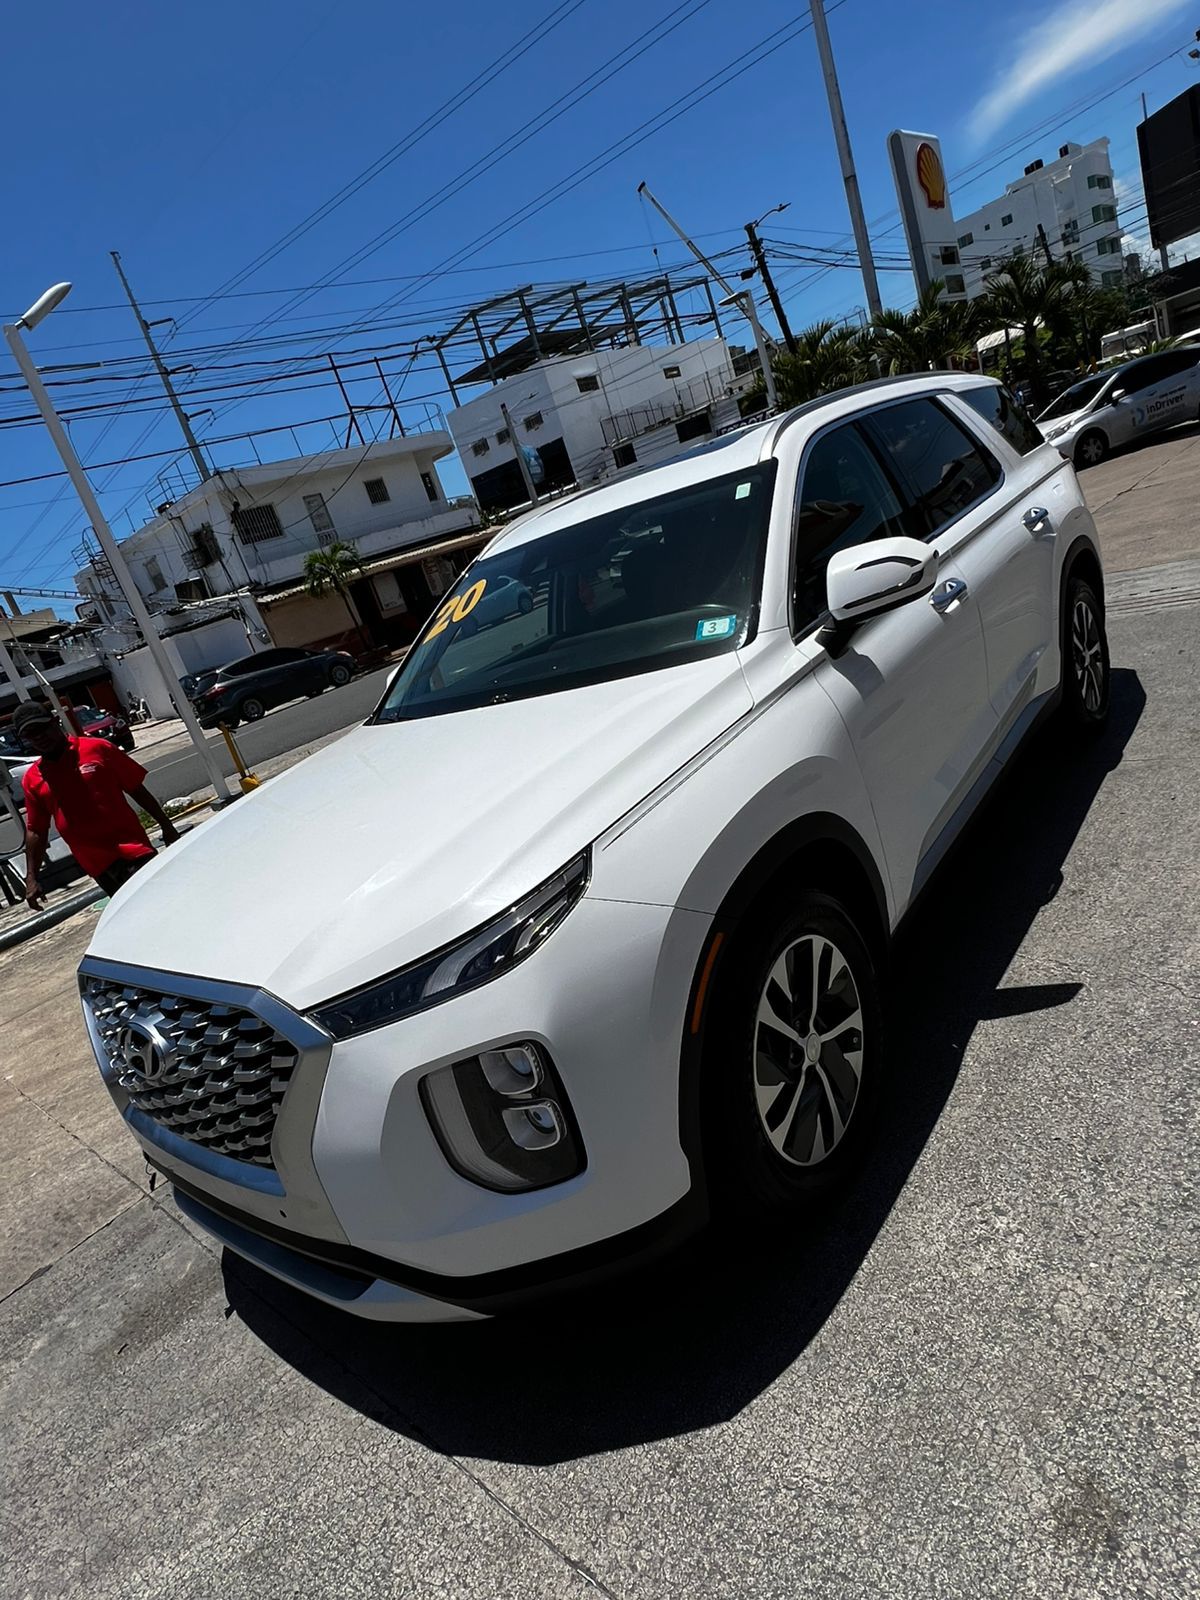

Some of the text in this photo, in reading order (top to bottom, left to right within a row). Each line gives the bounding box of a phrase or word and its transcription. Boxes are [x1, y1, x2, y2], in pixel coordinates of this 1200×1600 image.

[1146, 394, 1185, 414] inDriver
[422, 578, 487, 645] 20
[707, 621, 717, 634] 3
